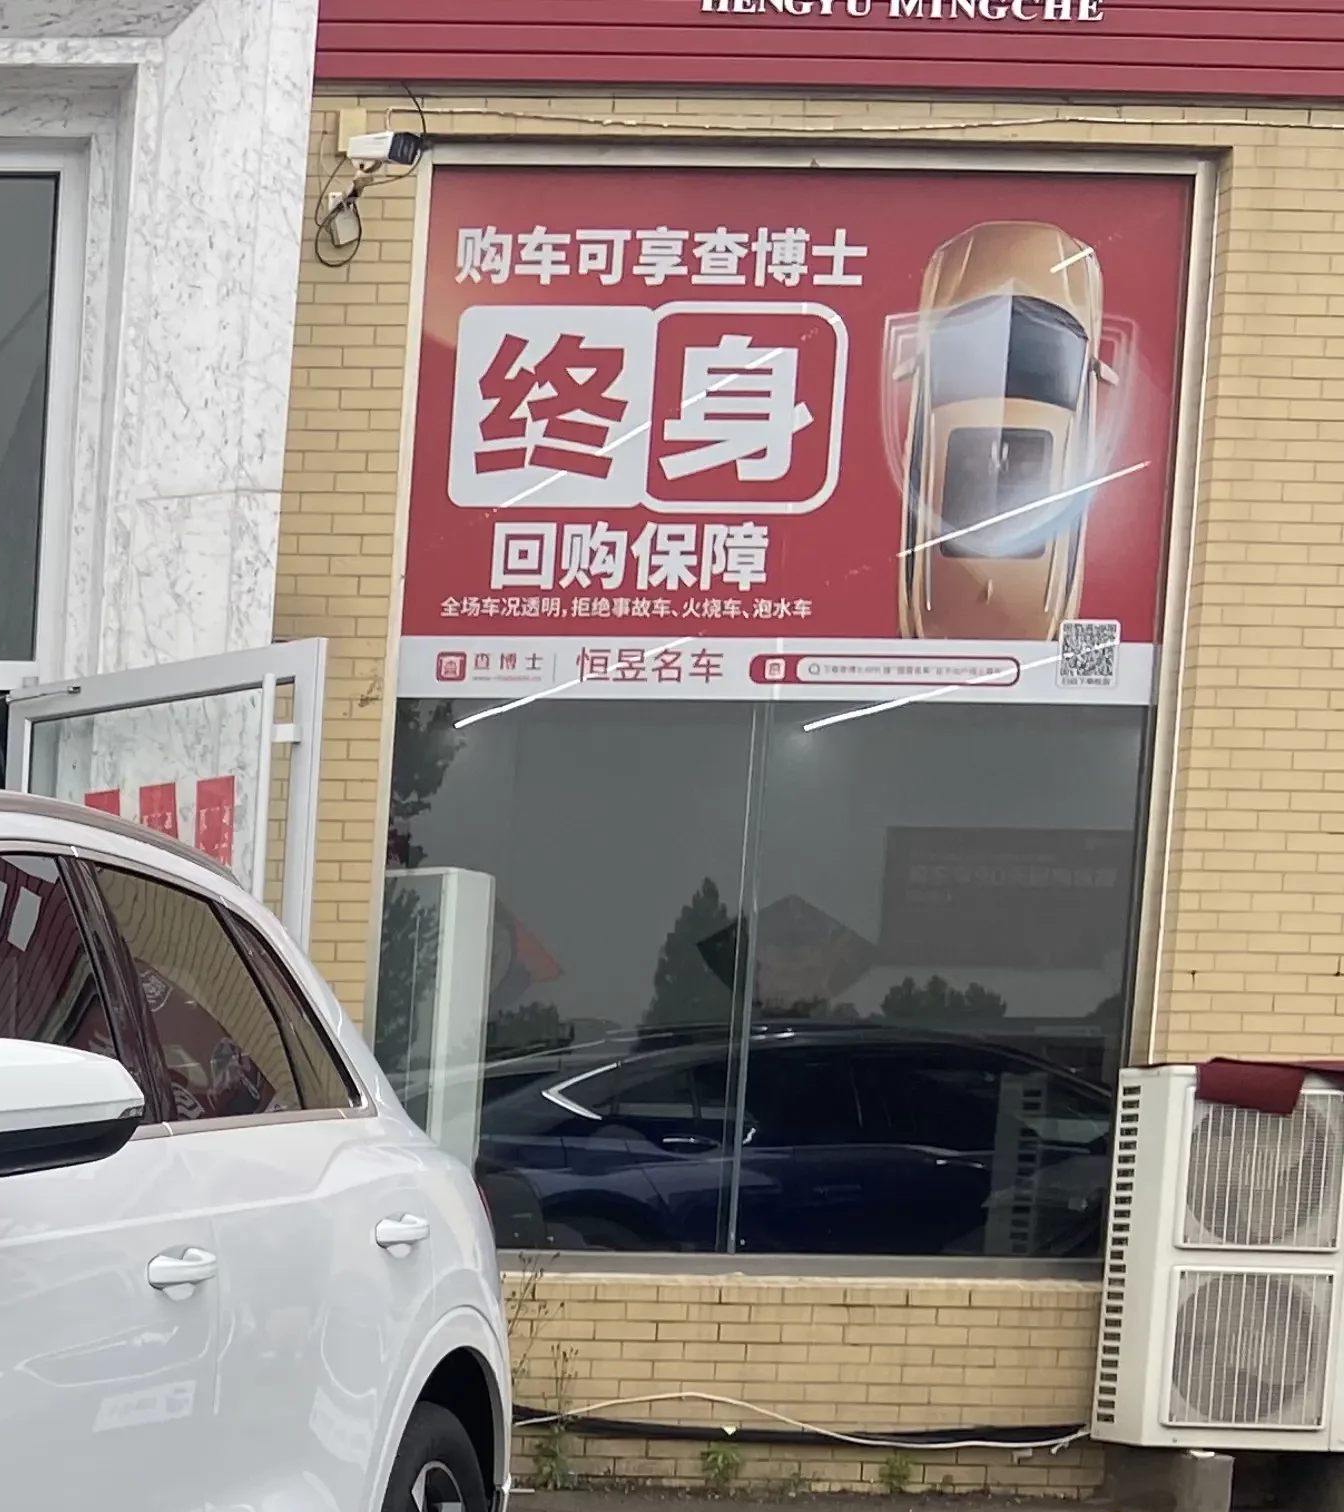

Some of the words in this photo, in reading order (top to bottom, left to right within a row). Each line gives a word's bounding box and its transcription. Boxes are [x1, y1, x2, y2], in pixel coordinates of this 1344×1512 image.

[888, 0, 1105, 22] MINGCHE
[454, 225, 868, 287] 购车可享查博士
[473, 332, 815, 482] 终身
[489, 522, 770, 591] 回购保障
